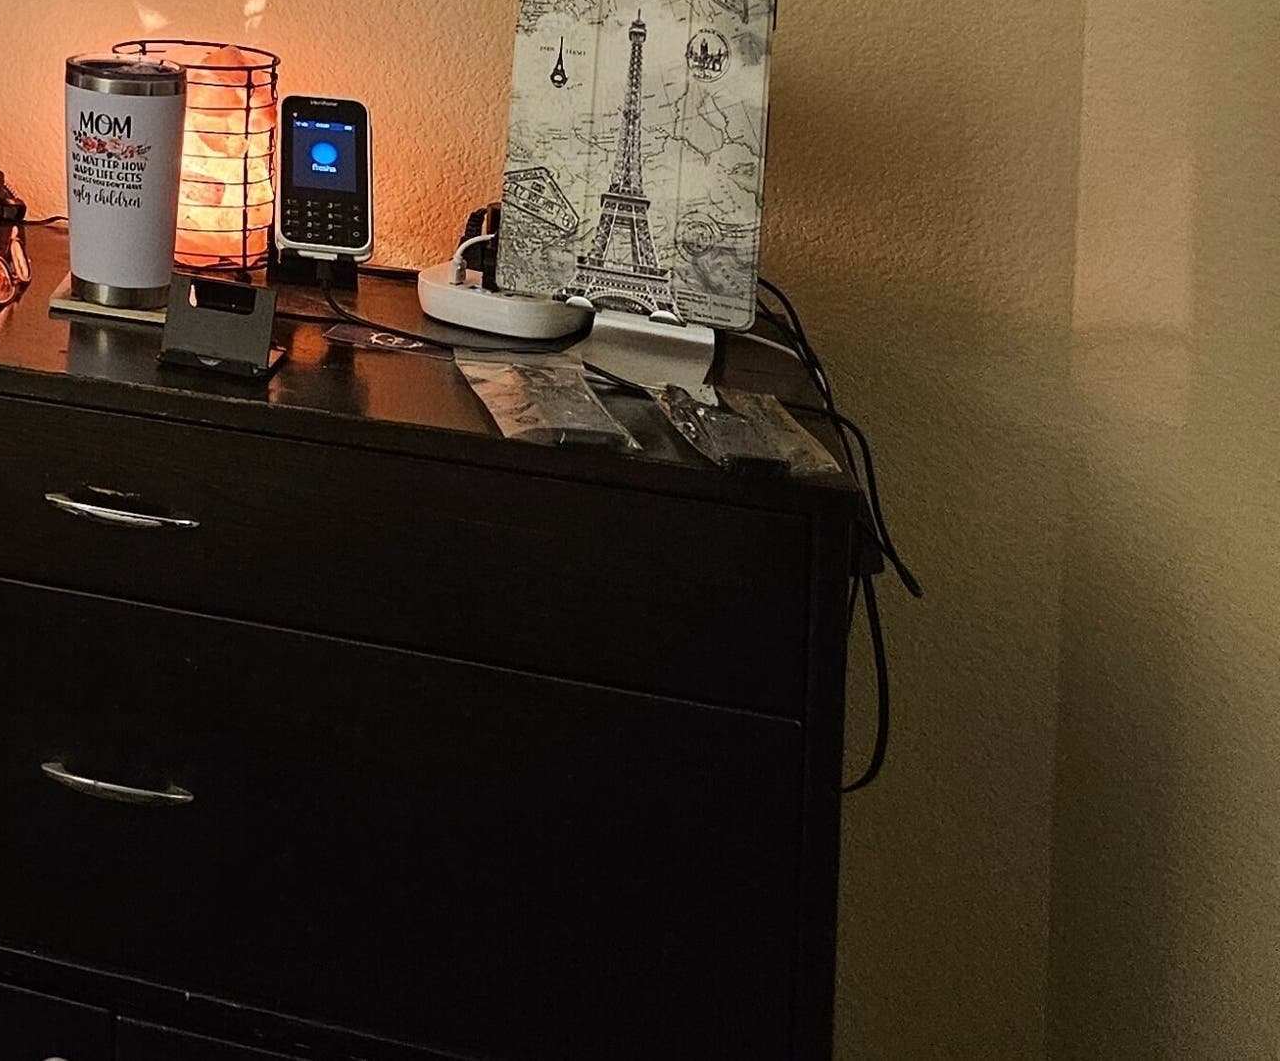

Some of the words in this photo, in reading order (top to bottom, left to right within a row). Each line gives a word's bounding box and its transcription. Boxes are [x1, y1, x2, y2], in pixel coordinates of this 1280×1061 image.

[80, 110, 132, 139] MOM
[83, 155, 120, 169] MATTER
[122, 161, 146, 172] HOW
[96, 169, 114, 180] LIFE
[117, 172, 142, 183] GETS
[94, 188, 144, 208] children
